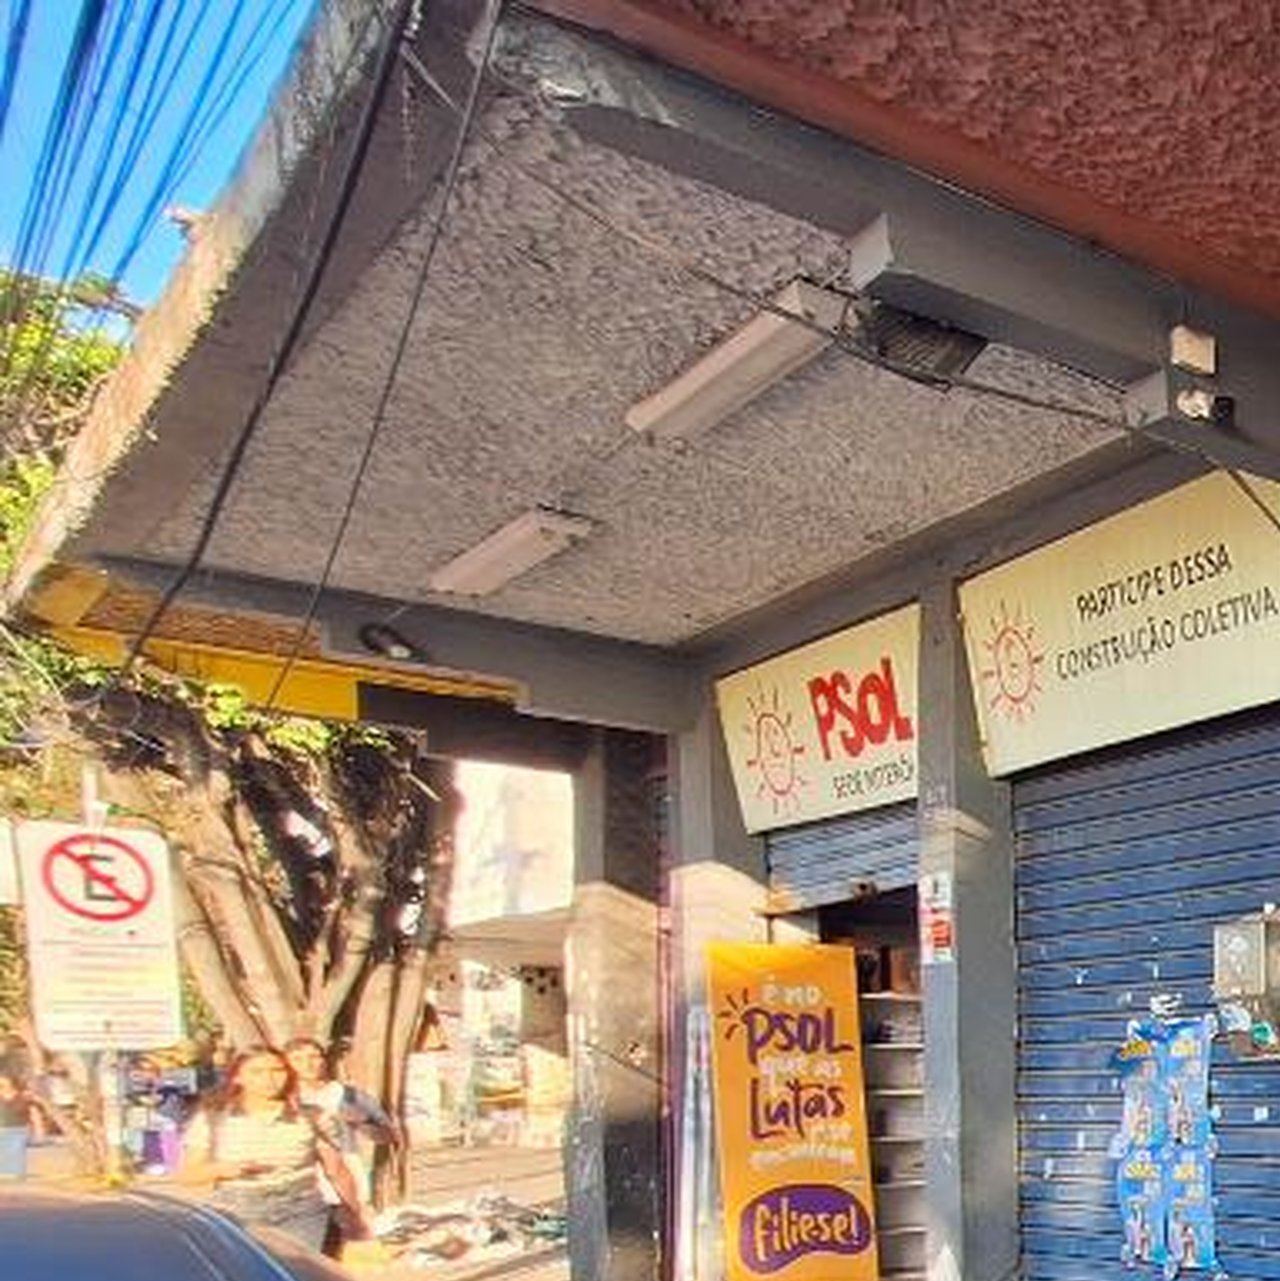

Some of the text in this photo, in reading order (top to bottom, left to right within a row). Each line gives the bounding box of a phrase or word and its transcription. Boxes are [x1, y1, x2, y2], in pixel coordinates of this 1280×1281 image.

[1076, 542, 1233, 622] PARTICIPE DESSA
[1055, 586, 1280, 682] CONSTRUÇÃO COLETIVA
[806, 656, 914, 761] PSOL
[742, 1007, 855, 1065] PSOL
